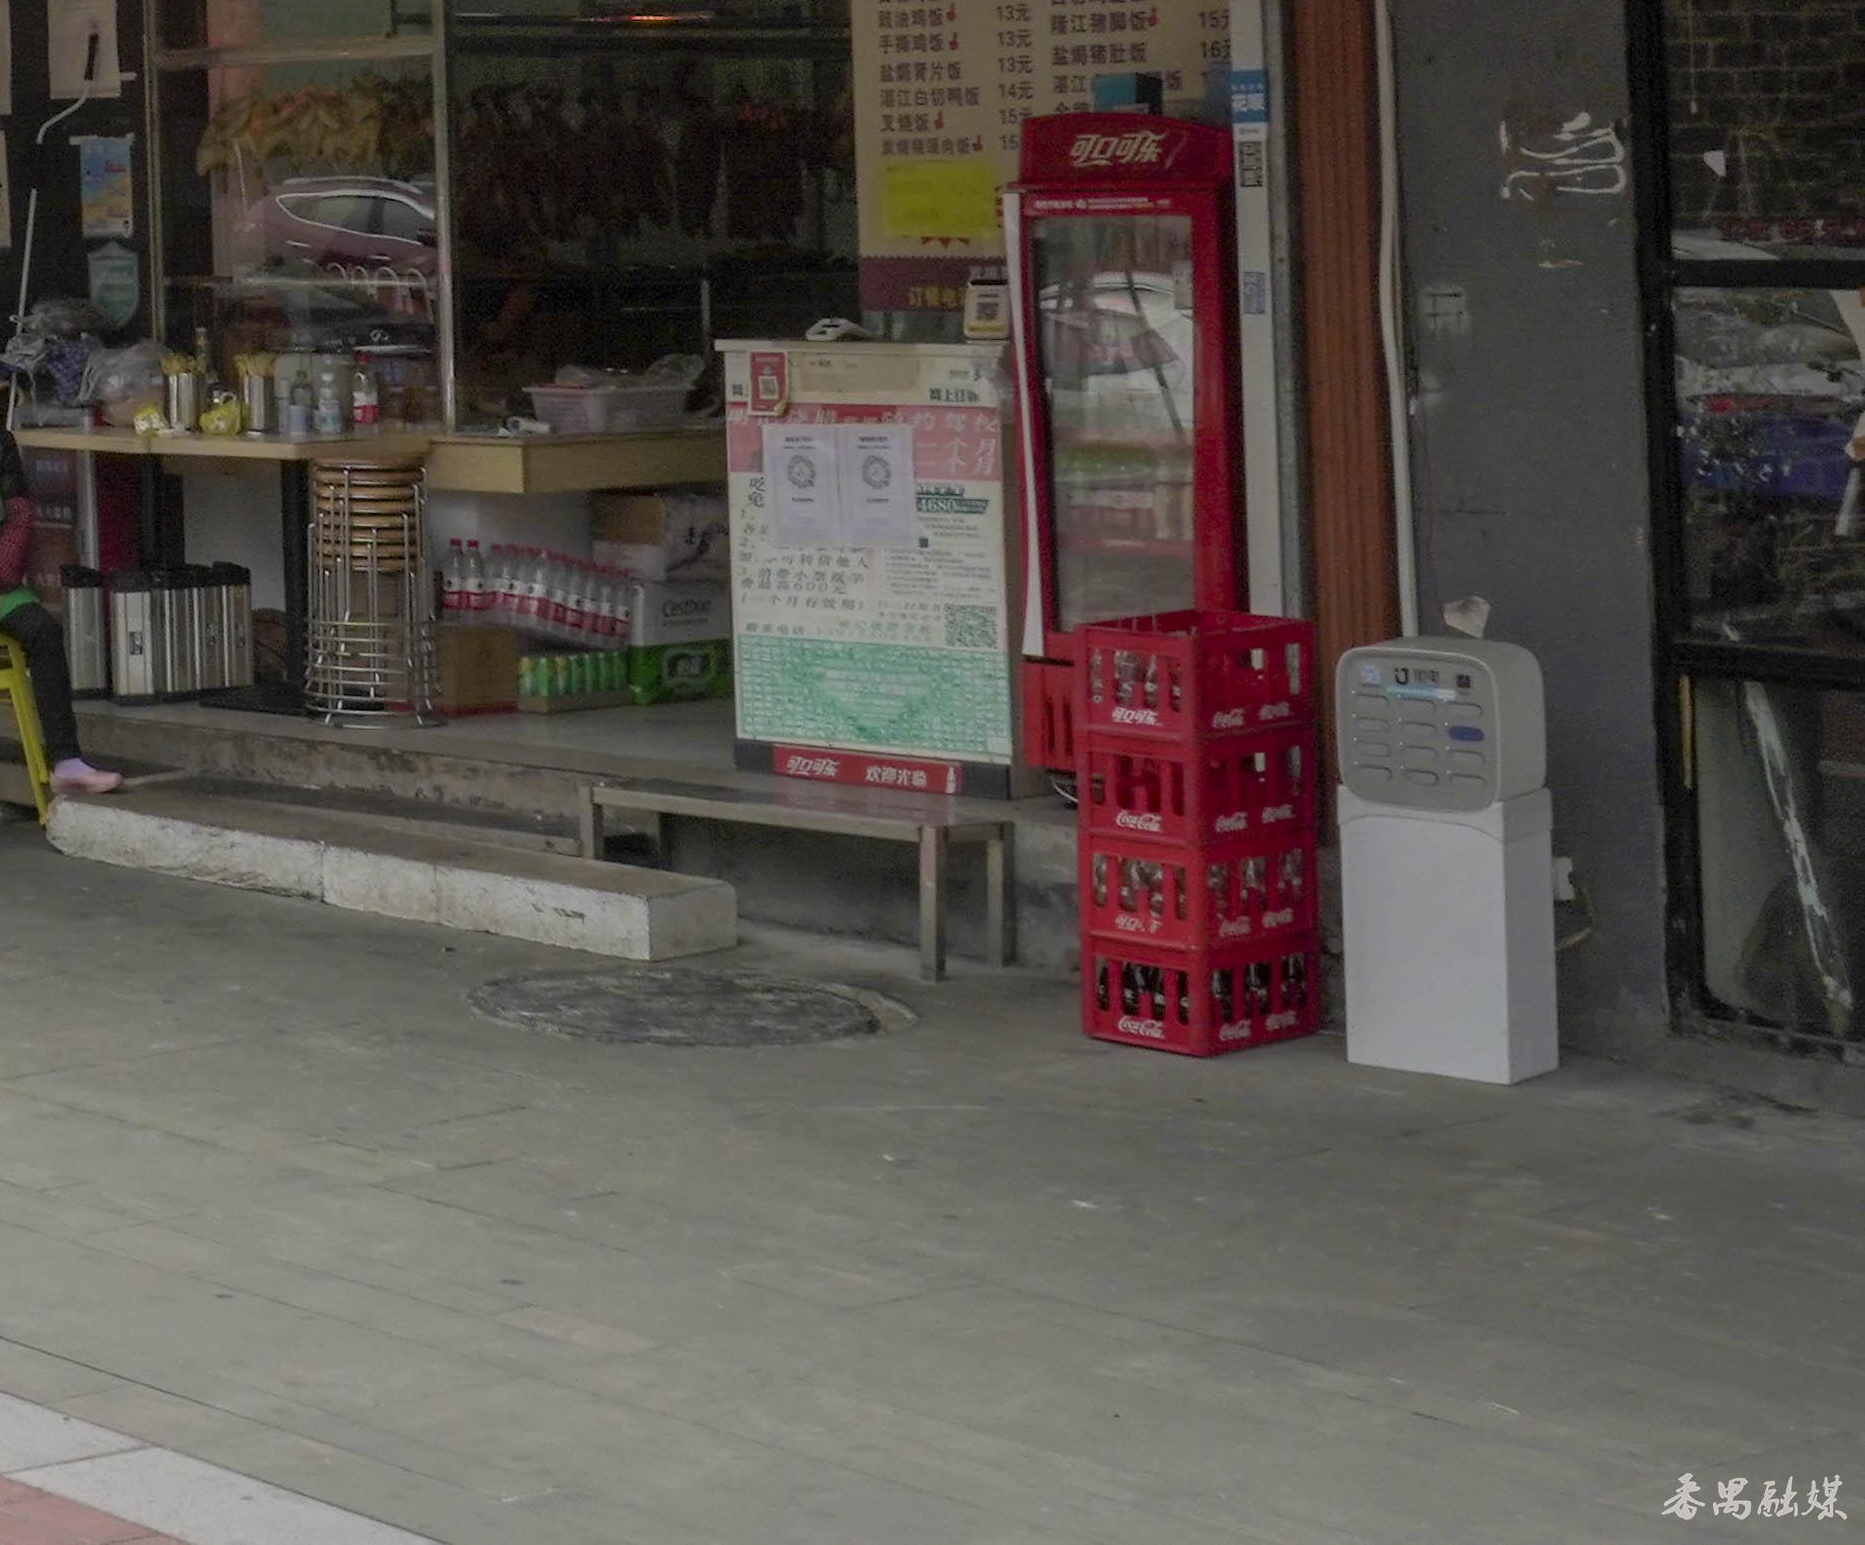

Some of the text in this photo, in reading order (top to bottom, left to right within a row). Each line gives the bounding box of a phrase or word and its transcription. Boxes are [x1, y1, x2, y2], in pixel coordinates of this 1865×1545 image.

[996, 5, 1030, 23] 13元
[997, 30, 1032, 49] 13元
[998, 56, 1032, 74] 13元
[998, 82, 1033, 101] 14元
[881, 113, 929, 134] 叉烧饭
[999, 136, 1020, 151] 16
[1069, 132, 1167, 168] 可口可乐
[1112, 706, 1161, 726] 可口可乐
[785, 755, 928, 788] 可口可乐 欢迎光临
